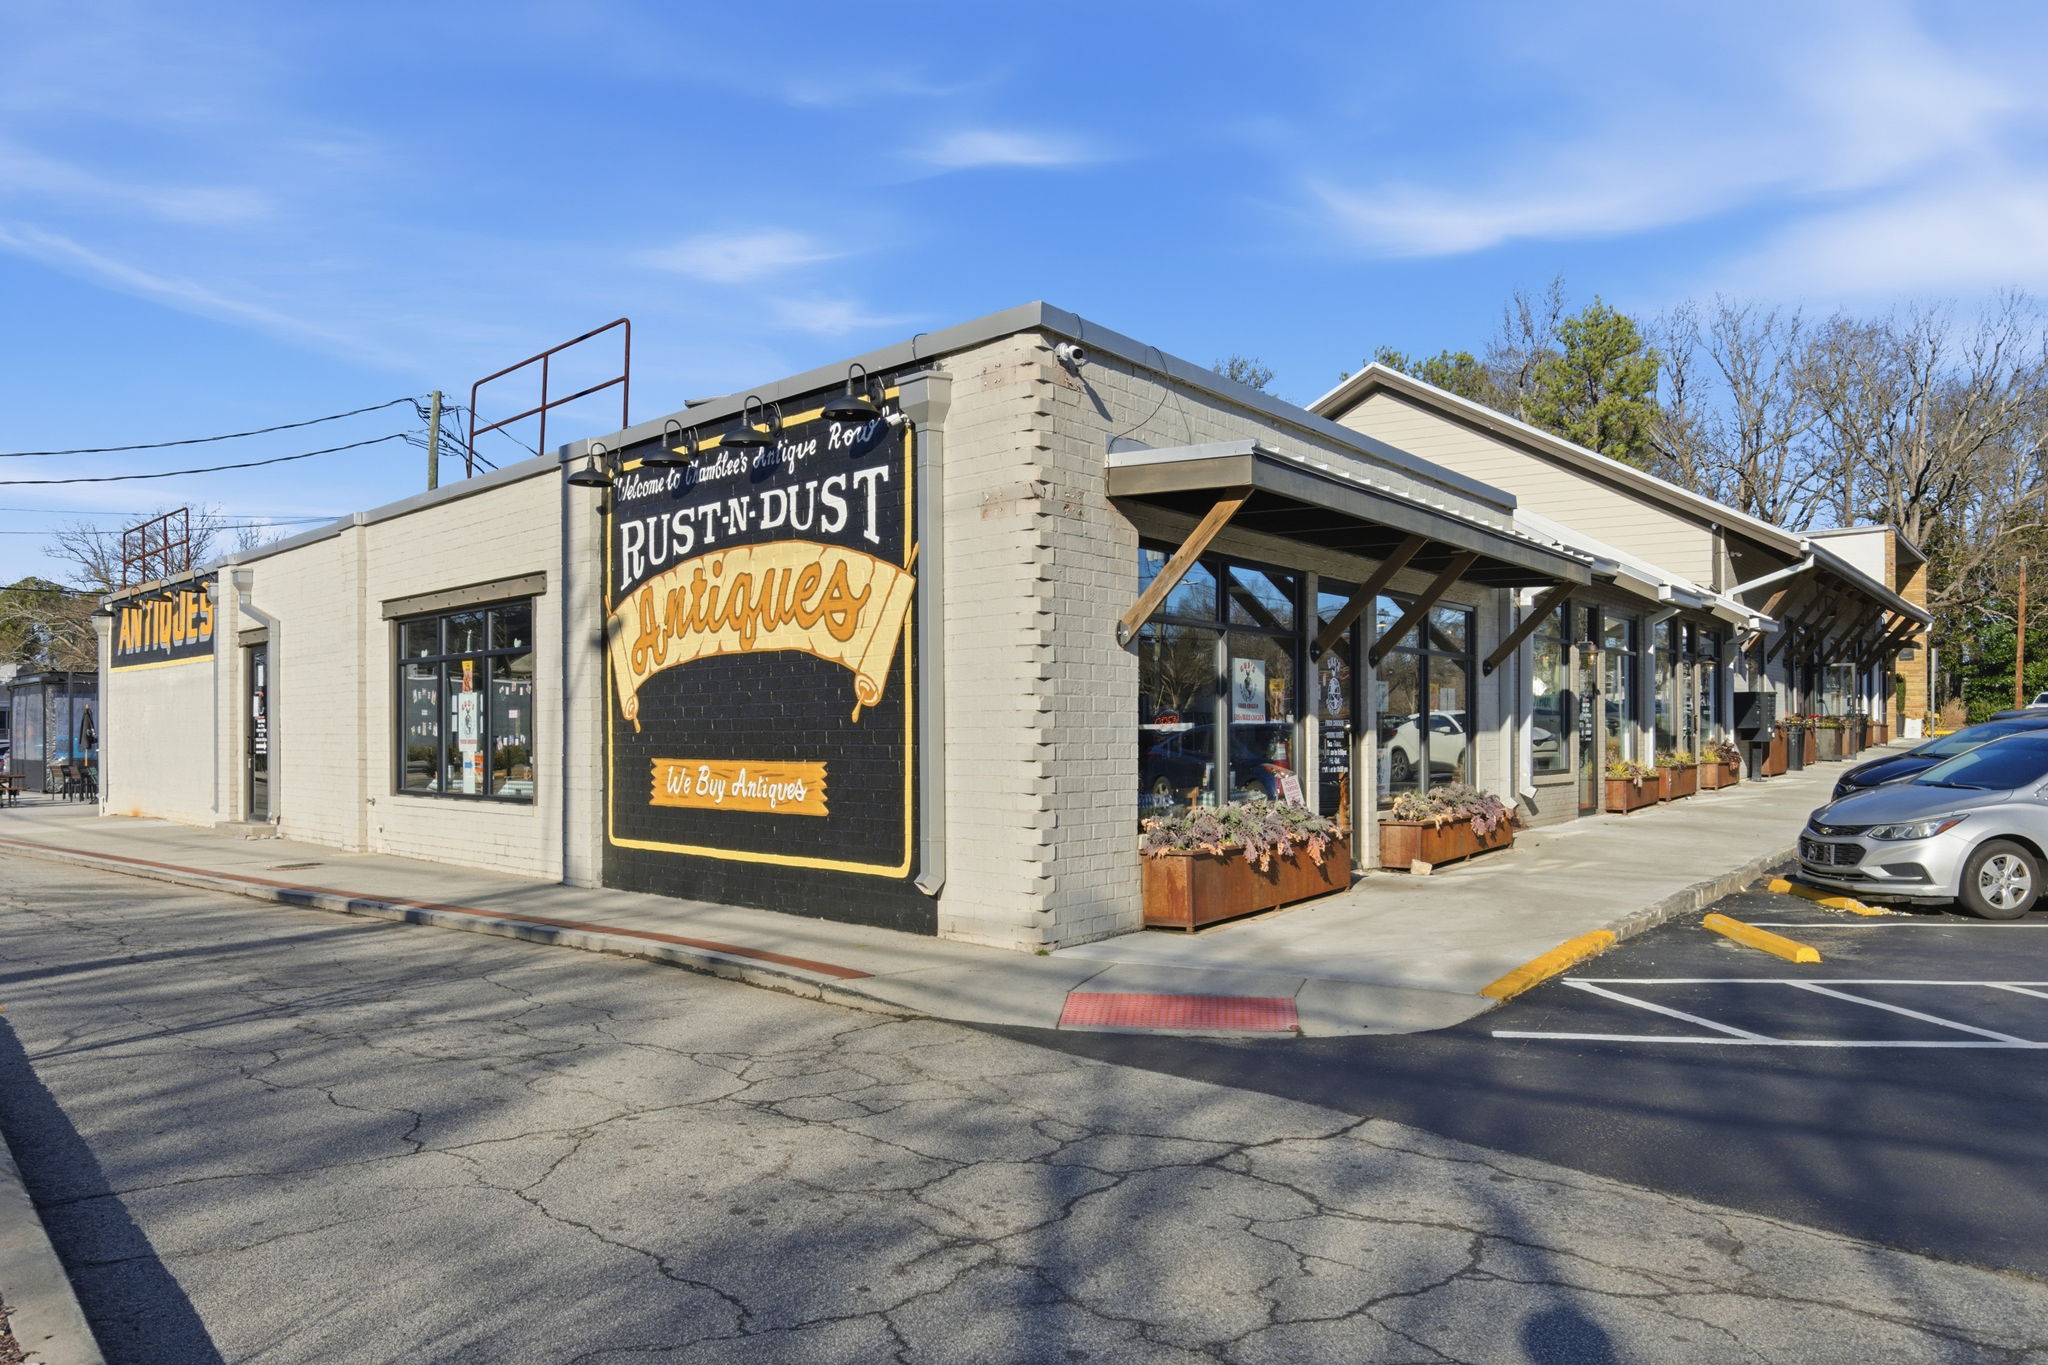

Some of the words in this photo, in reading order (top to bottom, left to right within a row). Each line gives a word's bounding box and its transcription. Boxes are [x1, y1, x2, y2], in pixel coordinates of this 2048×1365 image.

[666, 467, 681, 491] to
[753, 438, 817, 474] Antique
[620, 465, 889, 591] RUST-N-DUST
[117, 590, 214, 655] ANTIQUES
[631, 559, 871, 676] Antiques
[667, 765, 691, 795] We
[695, 765, 726, 804] Buy
[731, 767, 808, 809] Antiques
